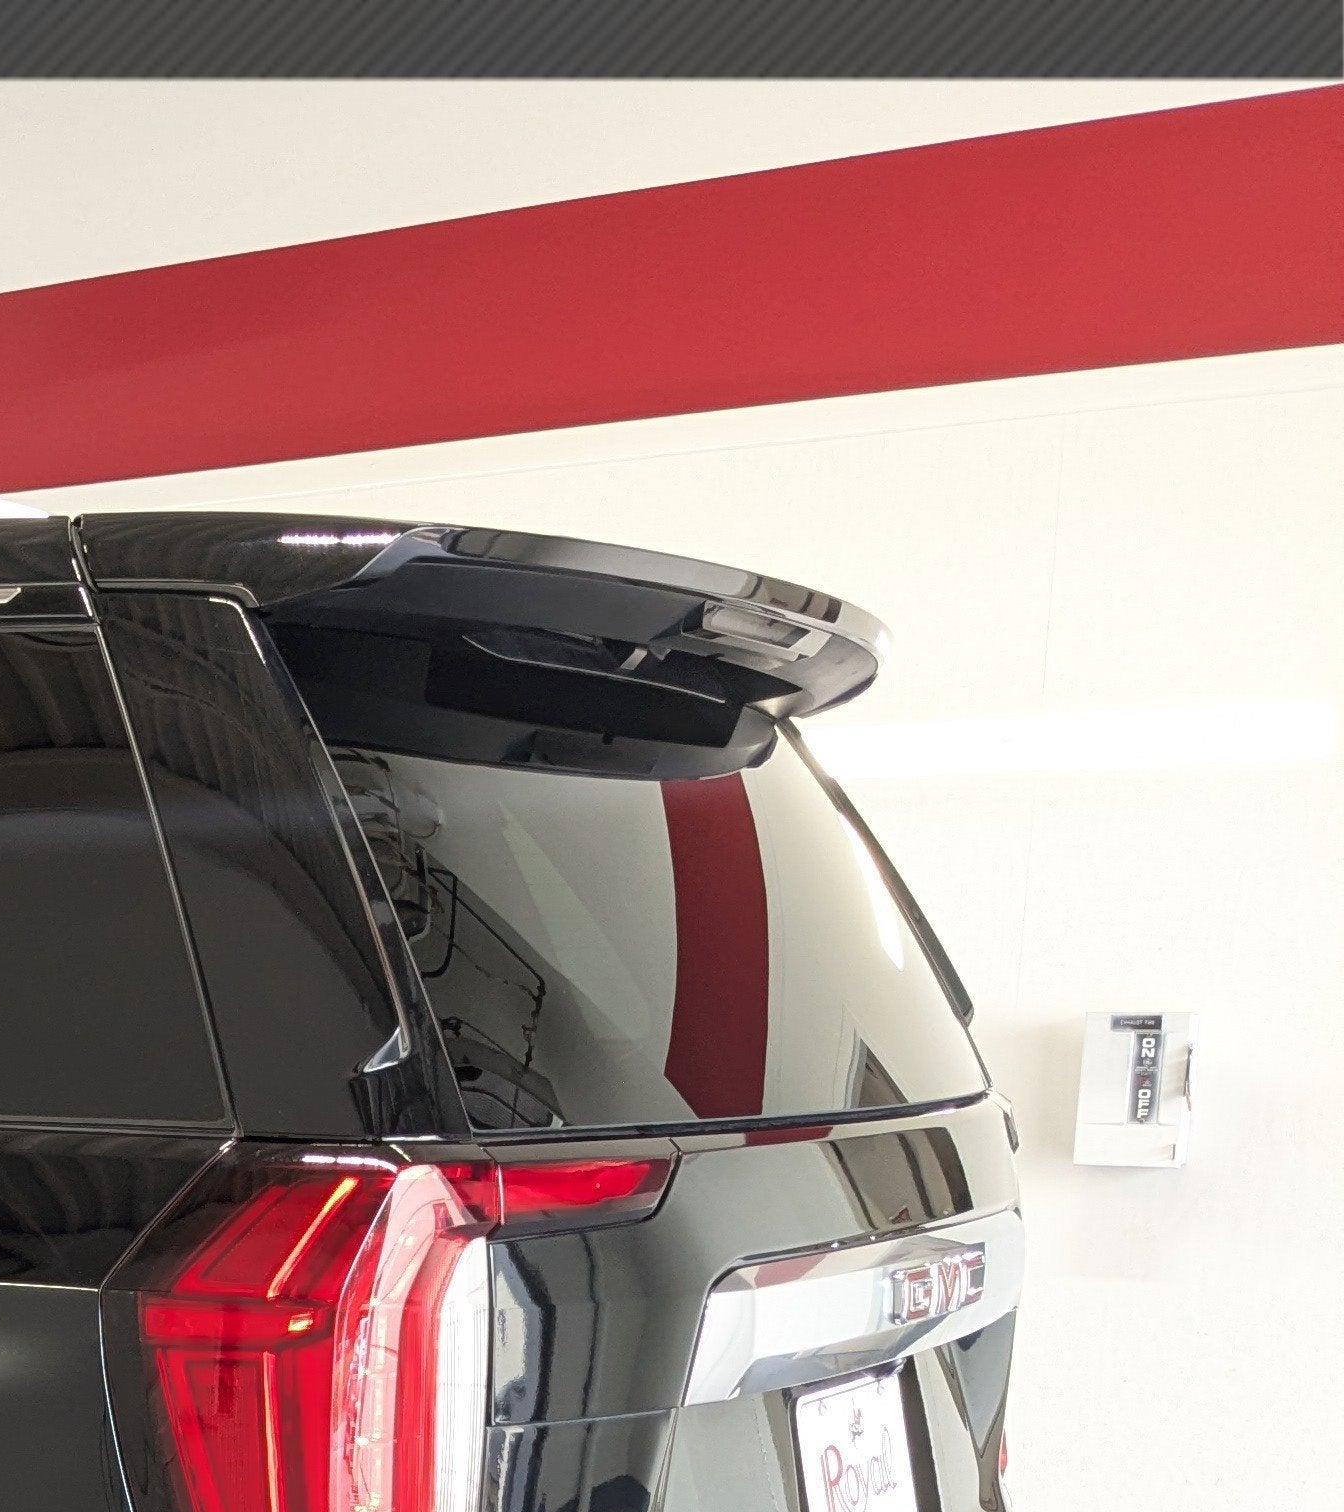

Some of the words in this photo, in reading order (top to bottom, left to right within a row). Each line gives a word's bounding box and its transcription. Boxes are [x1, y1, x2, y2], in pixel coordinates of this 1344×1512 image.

[1141, 1037, 1156, 1058] ON
[1136, 1088, 1151, 1118] OFF
[900, 1252, 985, 1321] GMC
